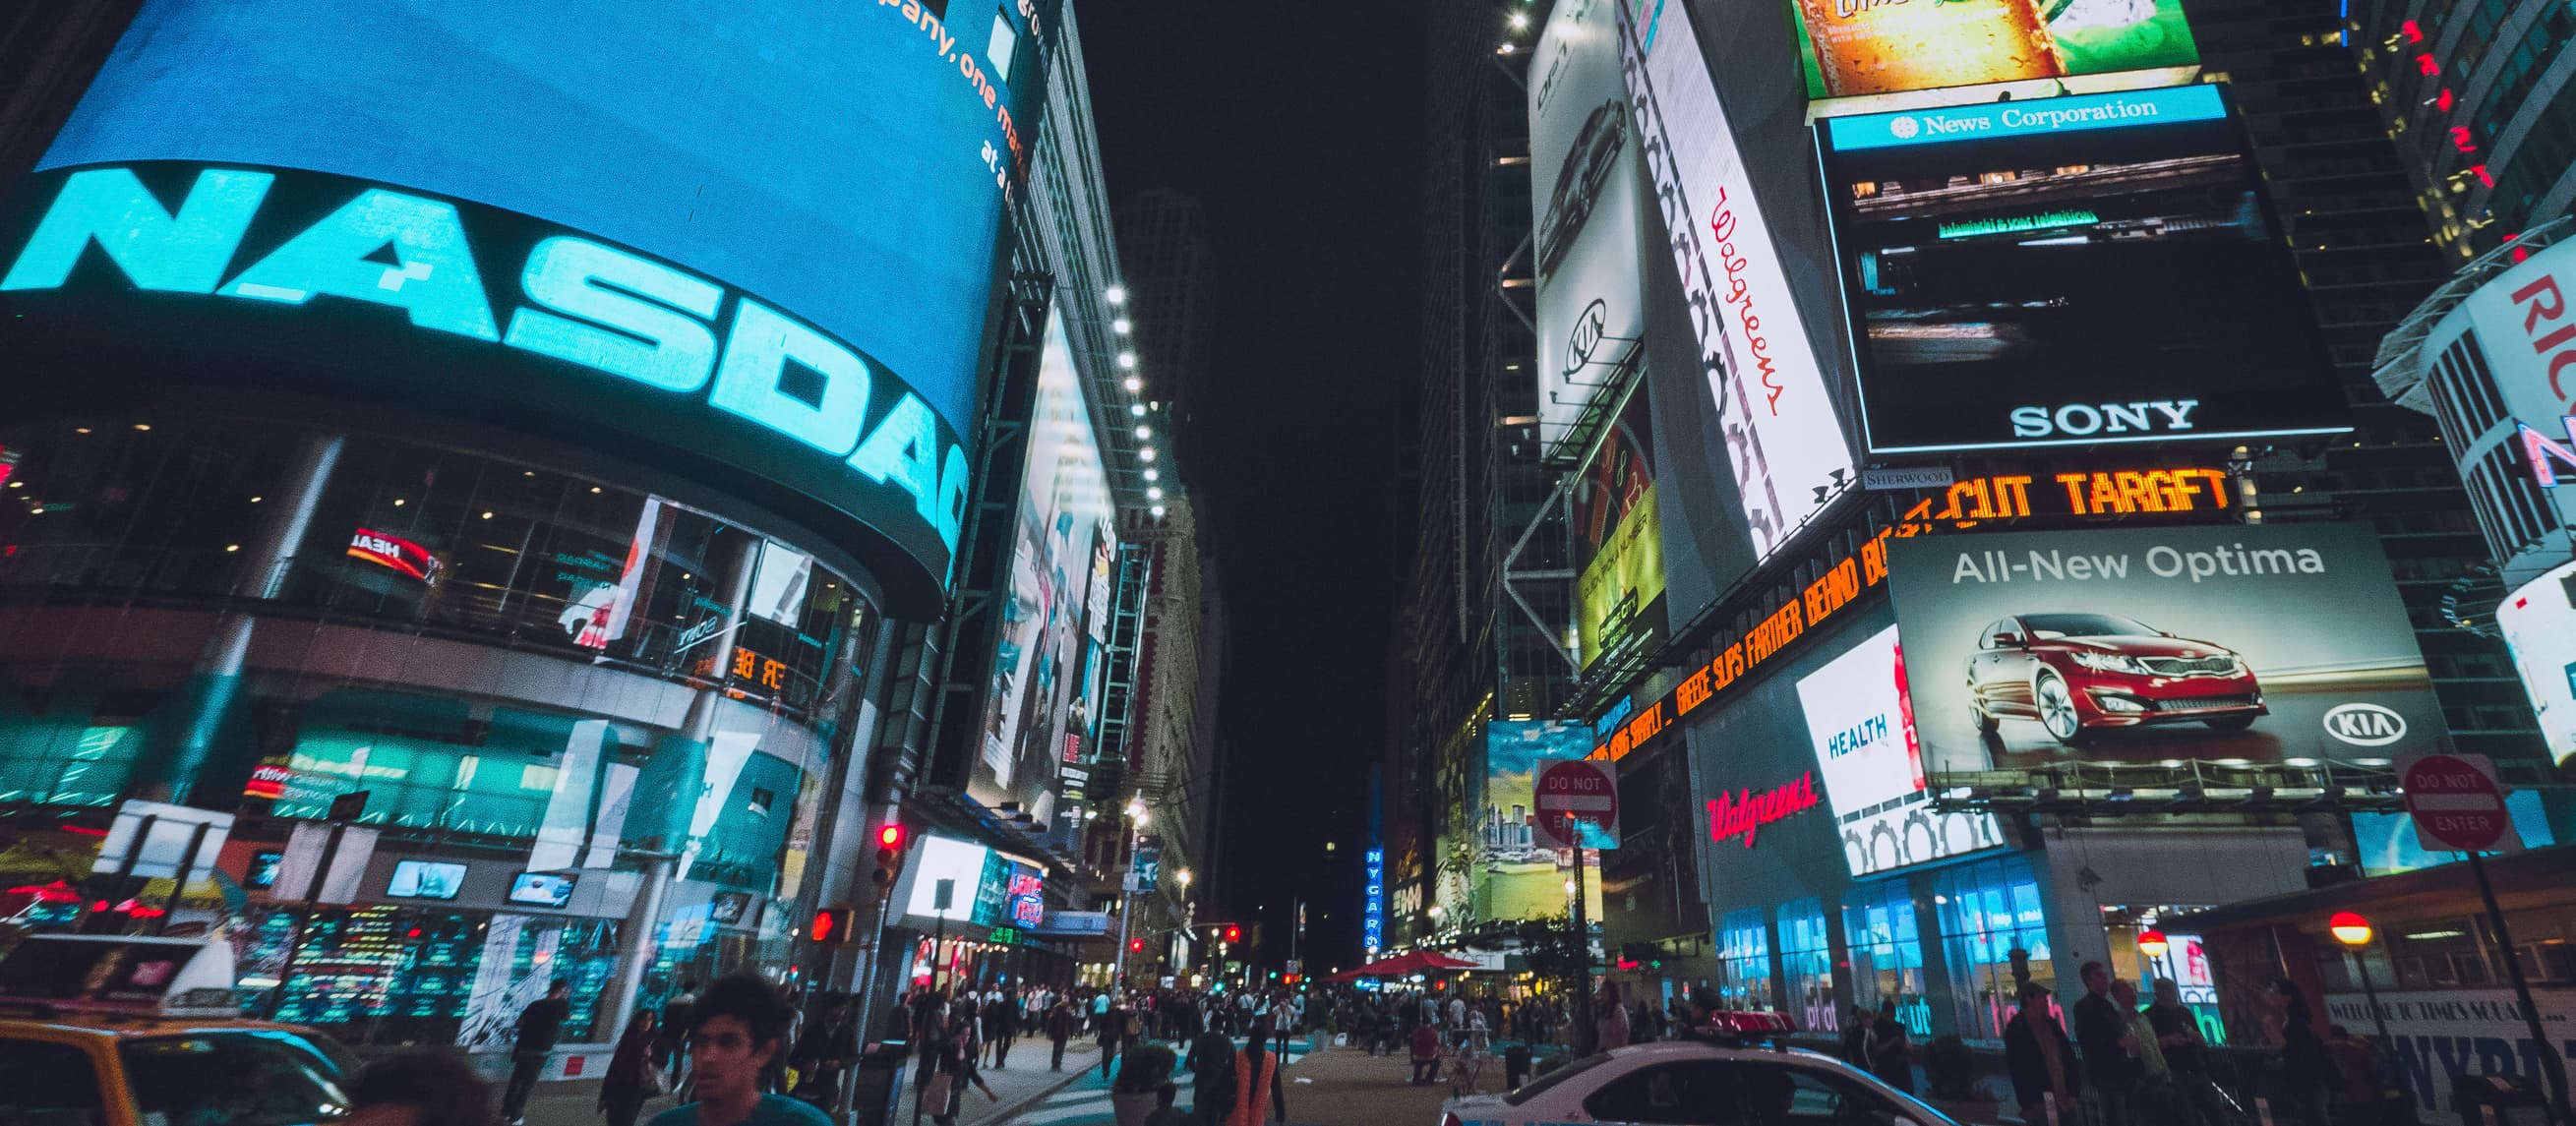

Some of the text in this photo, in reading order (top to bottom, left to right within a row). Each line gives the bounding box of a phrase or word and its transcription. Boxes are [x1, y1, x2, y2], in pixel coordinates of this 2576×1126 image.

[960, 53, 995, 110] one
[1923, 99, 2159, 136] News Corporation
[981, 140, 998, 173] at
[996, 165, 1005, 189] a
[1710, 186, 1783, 417] Walgreens
[1572, 311, 1601, 365] KIA
[2511, 273, 2576, 416] RIC
[2010, 399, 2199, 439] SONY
[1867, 470, 1950, 486] SHERWOOD
[1952, 543, 2326, 585] All-New Optima
[1712, 641, 1744, 691] SLIPS
[1744, 598, 1804, 670] FARTHER
[1803, 556, 1860, 627] BEHIND
[1827, 713, 1888, 760] HEALTH
[2336, 713, 2397, 736] KIA
[1549, 776, 1601, 791] DO NOT
[2415, 773, 2480, 789] DO NOT
[1707, 770, 1818, 849] Walgreens
[2434, 815, 2493, 832] ENTER
[2418, 1000, 2467, 1022] TIMES
